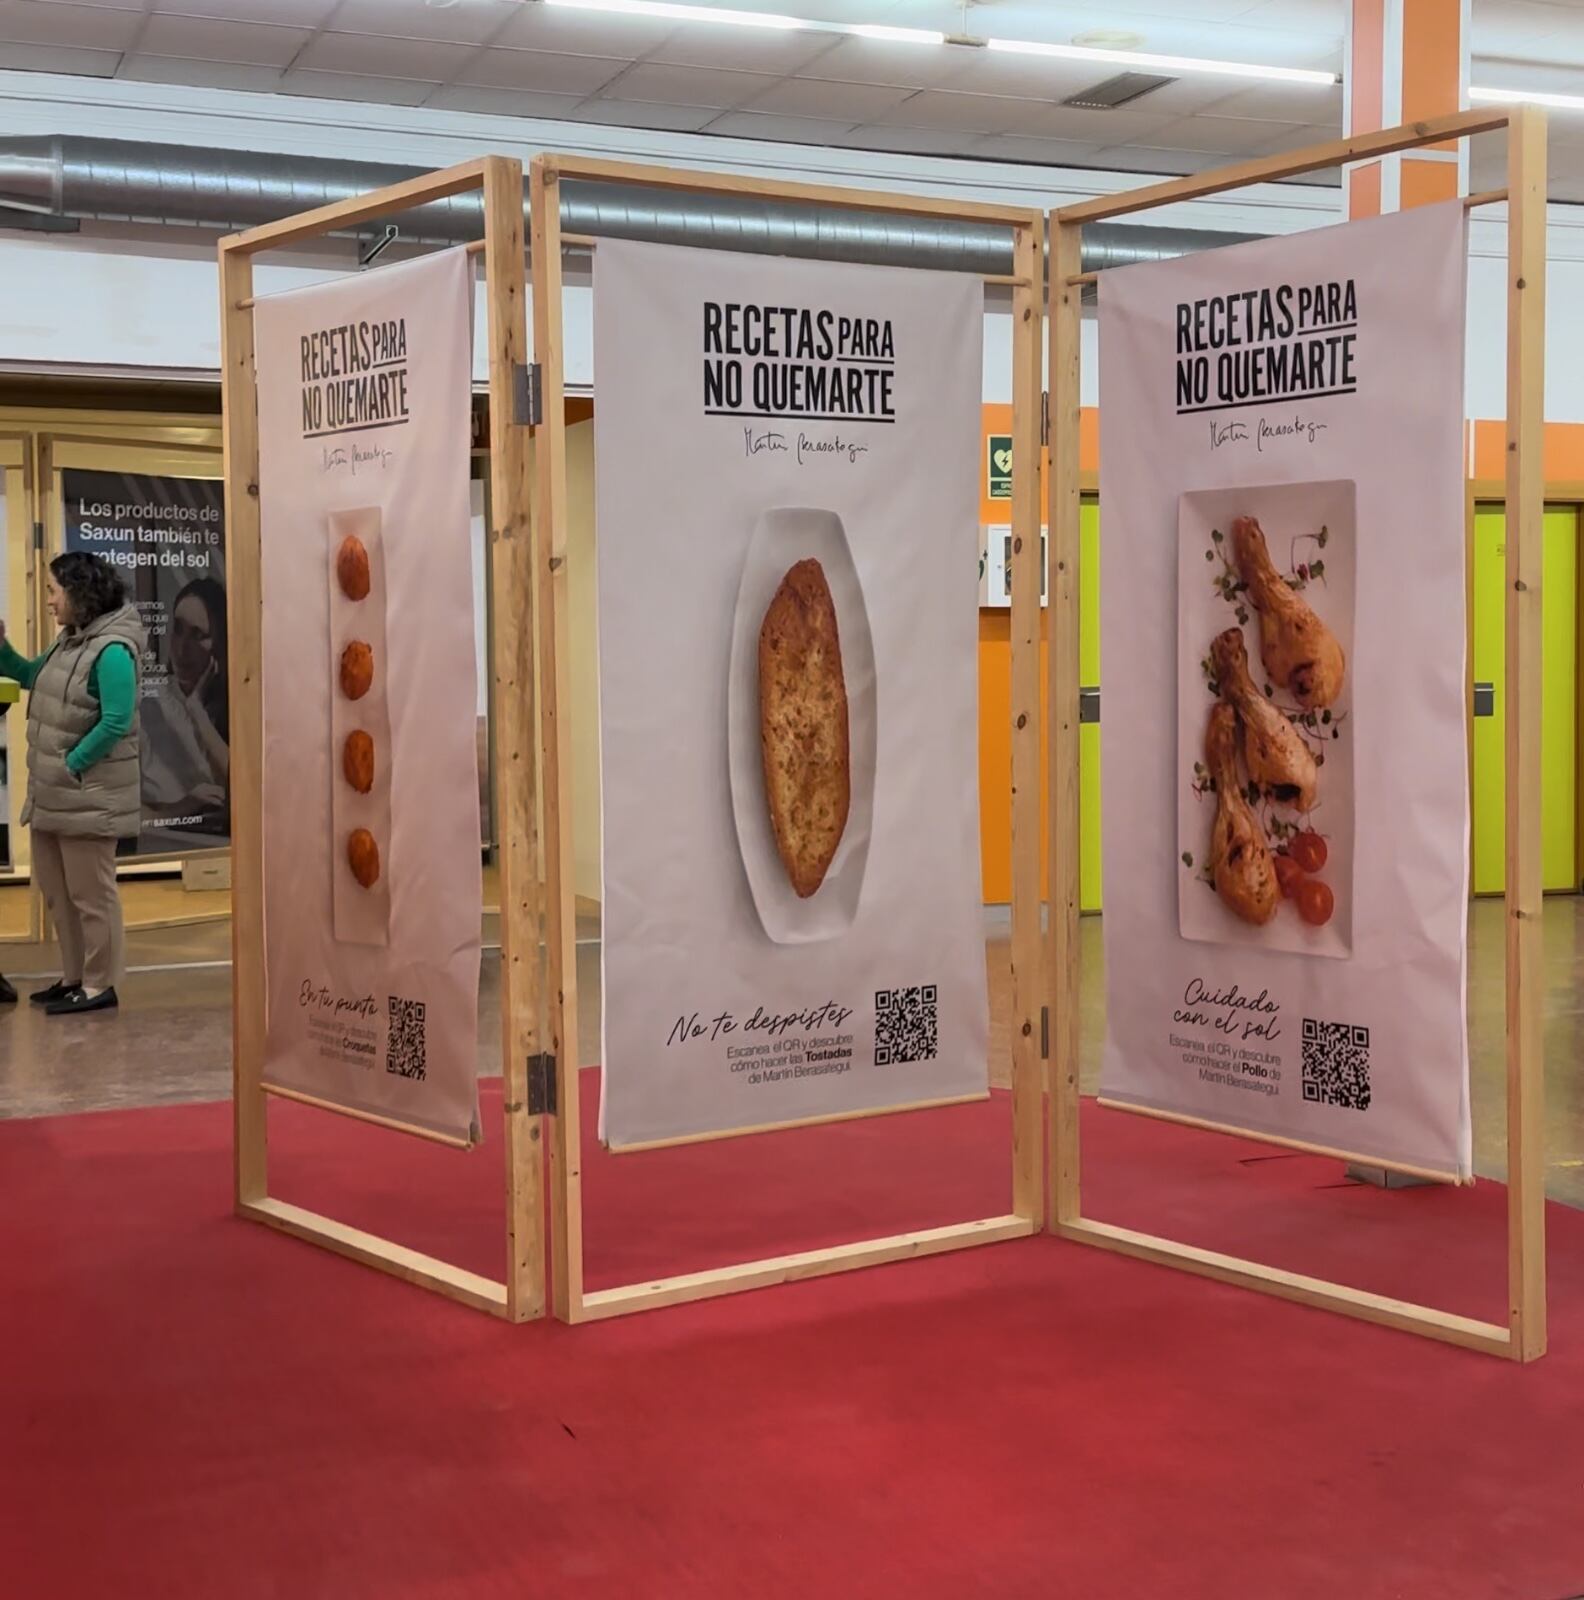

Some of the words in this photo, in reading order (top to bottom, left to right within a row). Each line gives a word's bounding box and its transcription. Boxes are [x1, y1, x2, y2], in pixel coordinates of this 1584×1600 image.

[704, 302, 833, 361] RECETAS
[838, 317, 894, 358] PARA
[1177, 285, 1294, 354] RECETAS
[1299, 279, 1357, 328] PARA
[301, 321, 370, 382] RECETAS
[372, 318, 407, 362] PARA
[1177, 356, 1208, 406] NO
[1218, 333, 1356, 402] QUEMARTE
[302, 385, 321, 431] NO
[326, 369, 409, 429] QUEMARTE
[704, 359, 742, 408] NO
[753, 362, 895, 415] QUEMARTE
[80, 498, 112, 516] Los
[115, 502, 198, 521] productos
[199, 505, 219, 522] de
[80, 522, 134, 541] Saxun
[137, 526, 201, 544] también
[204, 529, 219, 544] te
[160, 550, 184, 566] del
[187, 551, 209, 568] sol
[299, 979, 318, 1006] En
[318, 986, 334, 1010] tu
[334, 994, 378, 1019] punta
[1184, 978, 1280, 1013] Cuidado
[667, 1012, 708, 1046] No
[711, 1011, 738, 1041] te
[744, 1000, 854, 1035] despistes
[1173, 1010, 1209, 1026] con
[1215, 1009, 1239, 1034] el
[1241, 1016, 1281, 1041] sol
[727, 1044, 770, 1059] Escanea
[773, 1042, 782, 1053] el
[783, 1039, 801, 1052] QR
[801, 1041, 807, 1052] y
[810, 1033, 854, 1049] descubre
[730, 1058, 760, 1073] cómo
[760, 1056, 787, 1070] hacer
[789, 1053, 803, 1065] las
[805, 1047, 852, 1062] Tostadas
[1170, 1033, 1205, 1052] Escanea
[1207, 1042, 1215, 1053] el
[1216, 1043, 1231, 1056] QR
[1239, 1049, 1281, 1066] descubre
[748, 1072, 762, 1085] de
[1207, 1056, 1231, 1071] hacer
[1233, 1062, 1240, 1073] el
[1242, 1062, 1268, 1078] Pollo
[1269, 1069, 1281, 1080] de
